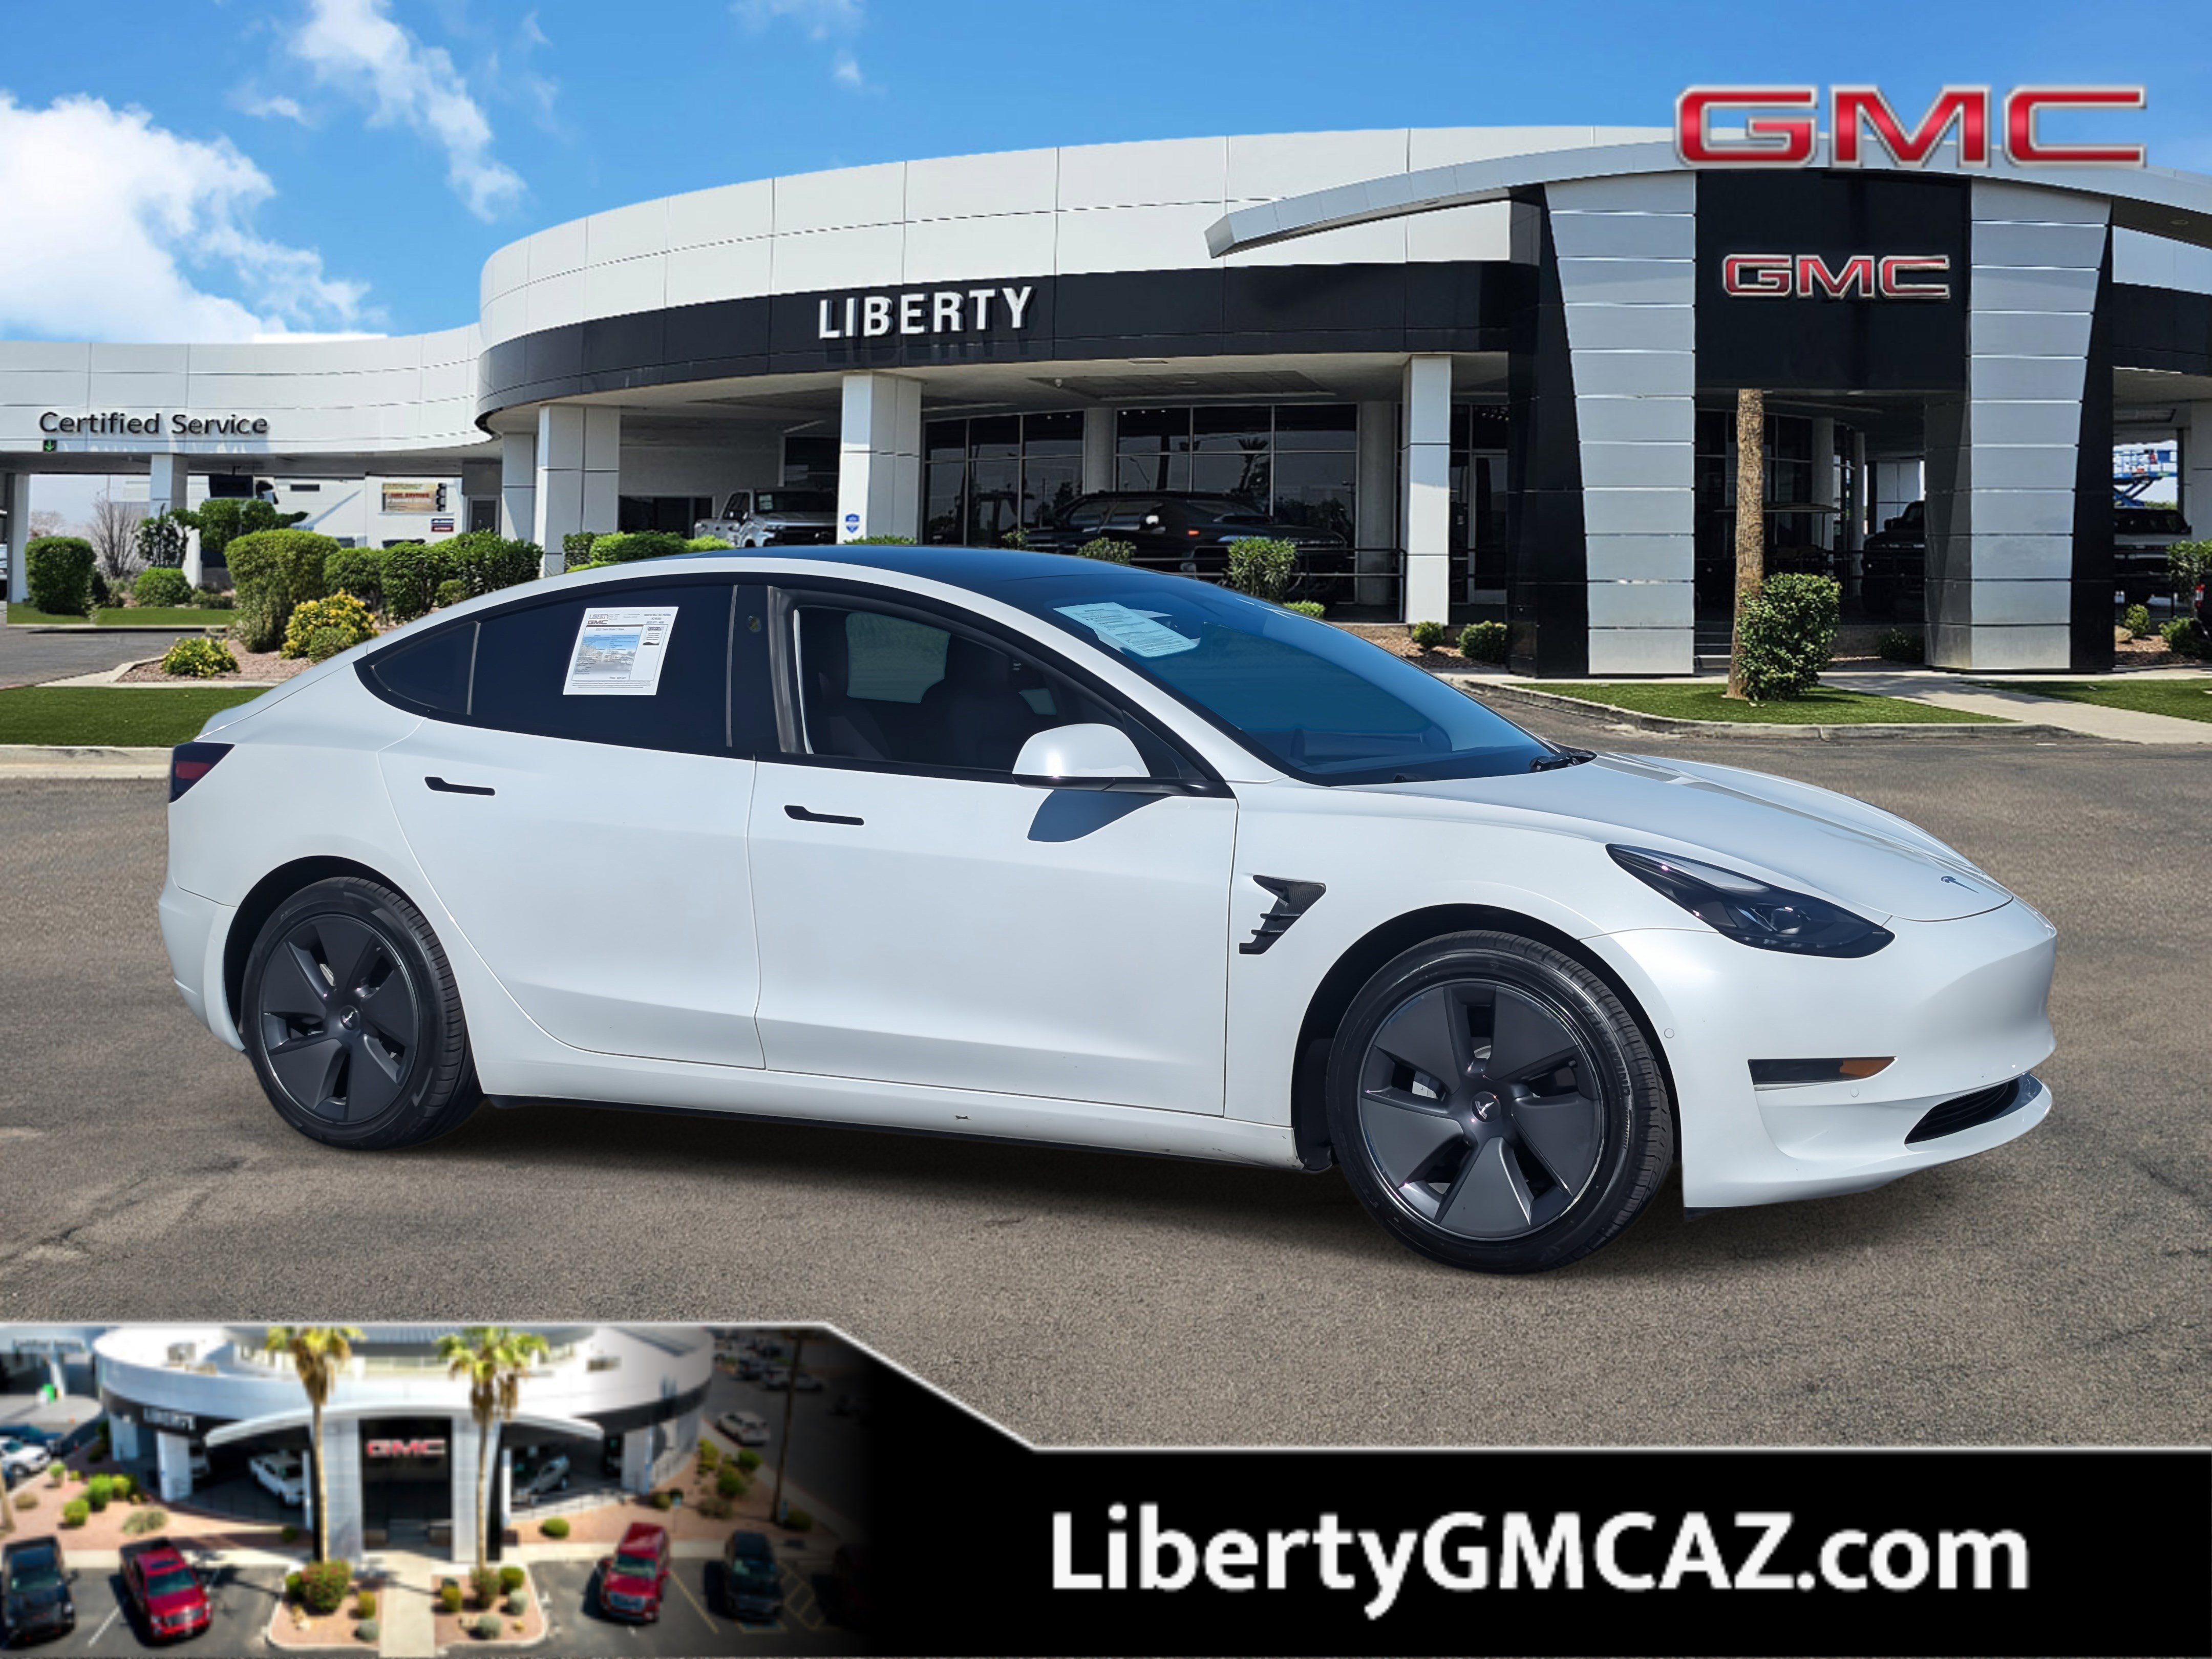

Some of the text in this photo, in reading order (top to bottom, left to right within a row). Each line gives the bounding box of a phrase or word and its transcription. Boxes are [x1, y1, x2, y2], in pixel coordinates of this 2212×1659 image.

[1722, 253, 1949, 300] GMC
[819, 286, 1033, 339] LIBERTY
[39, 411, 268, 435] Certified Service
